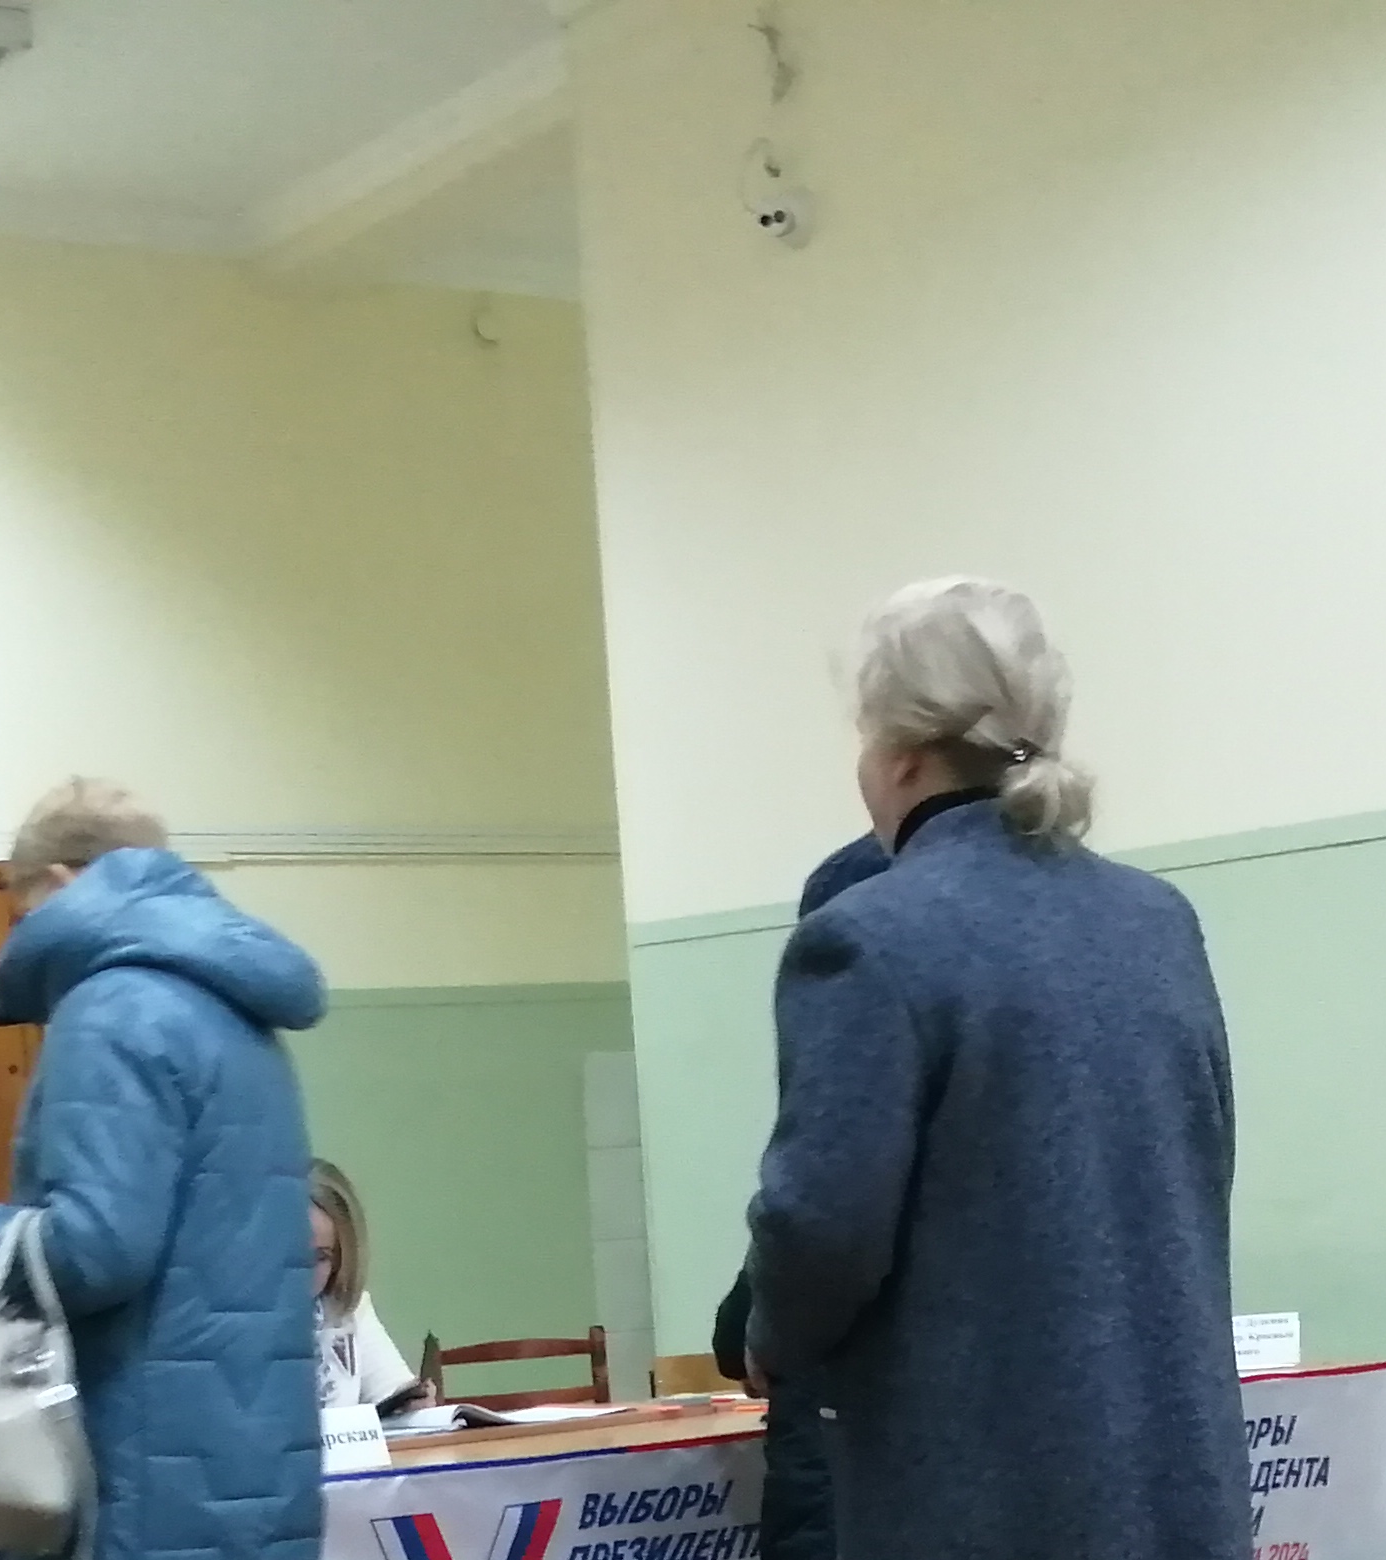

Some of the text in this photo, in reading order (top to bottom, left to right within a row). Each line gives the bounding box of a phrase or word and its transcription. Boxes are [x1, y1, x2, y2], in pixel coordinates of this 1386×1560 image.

[322, 1429, 379, 1449] рская
[1250, 1456, 1330, 1496] ДЕНТА
[578, 1480, 733, 1530] ВЫБОРЫ
